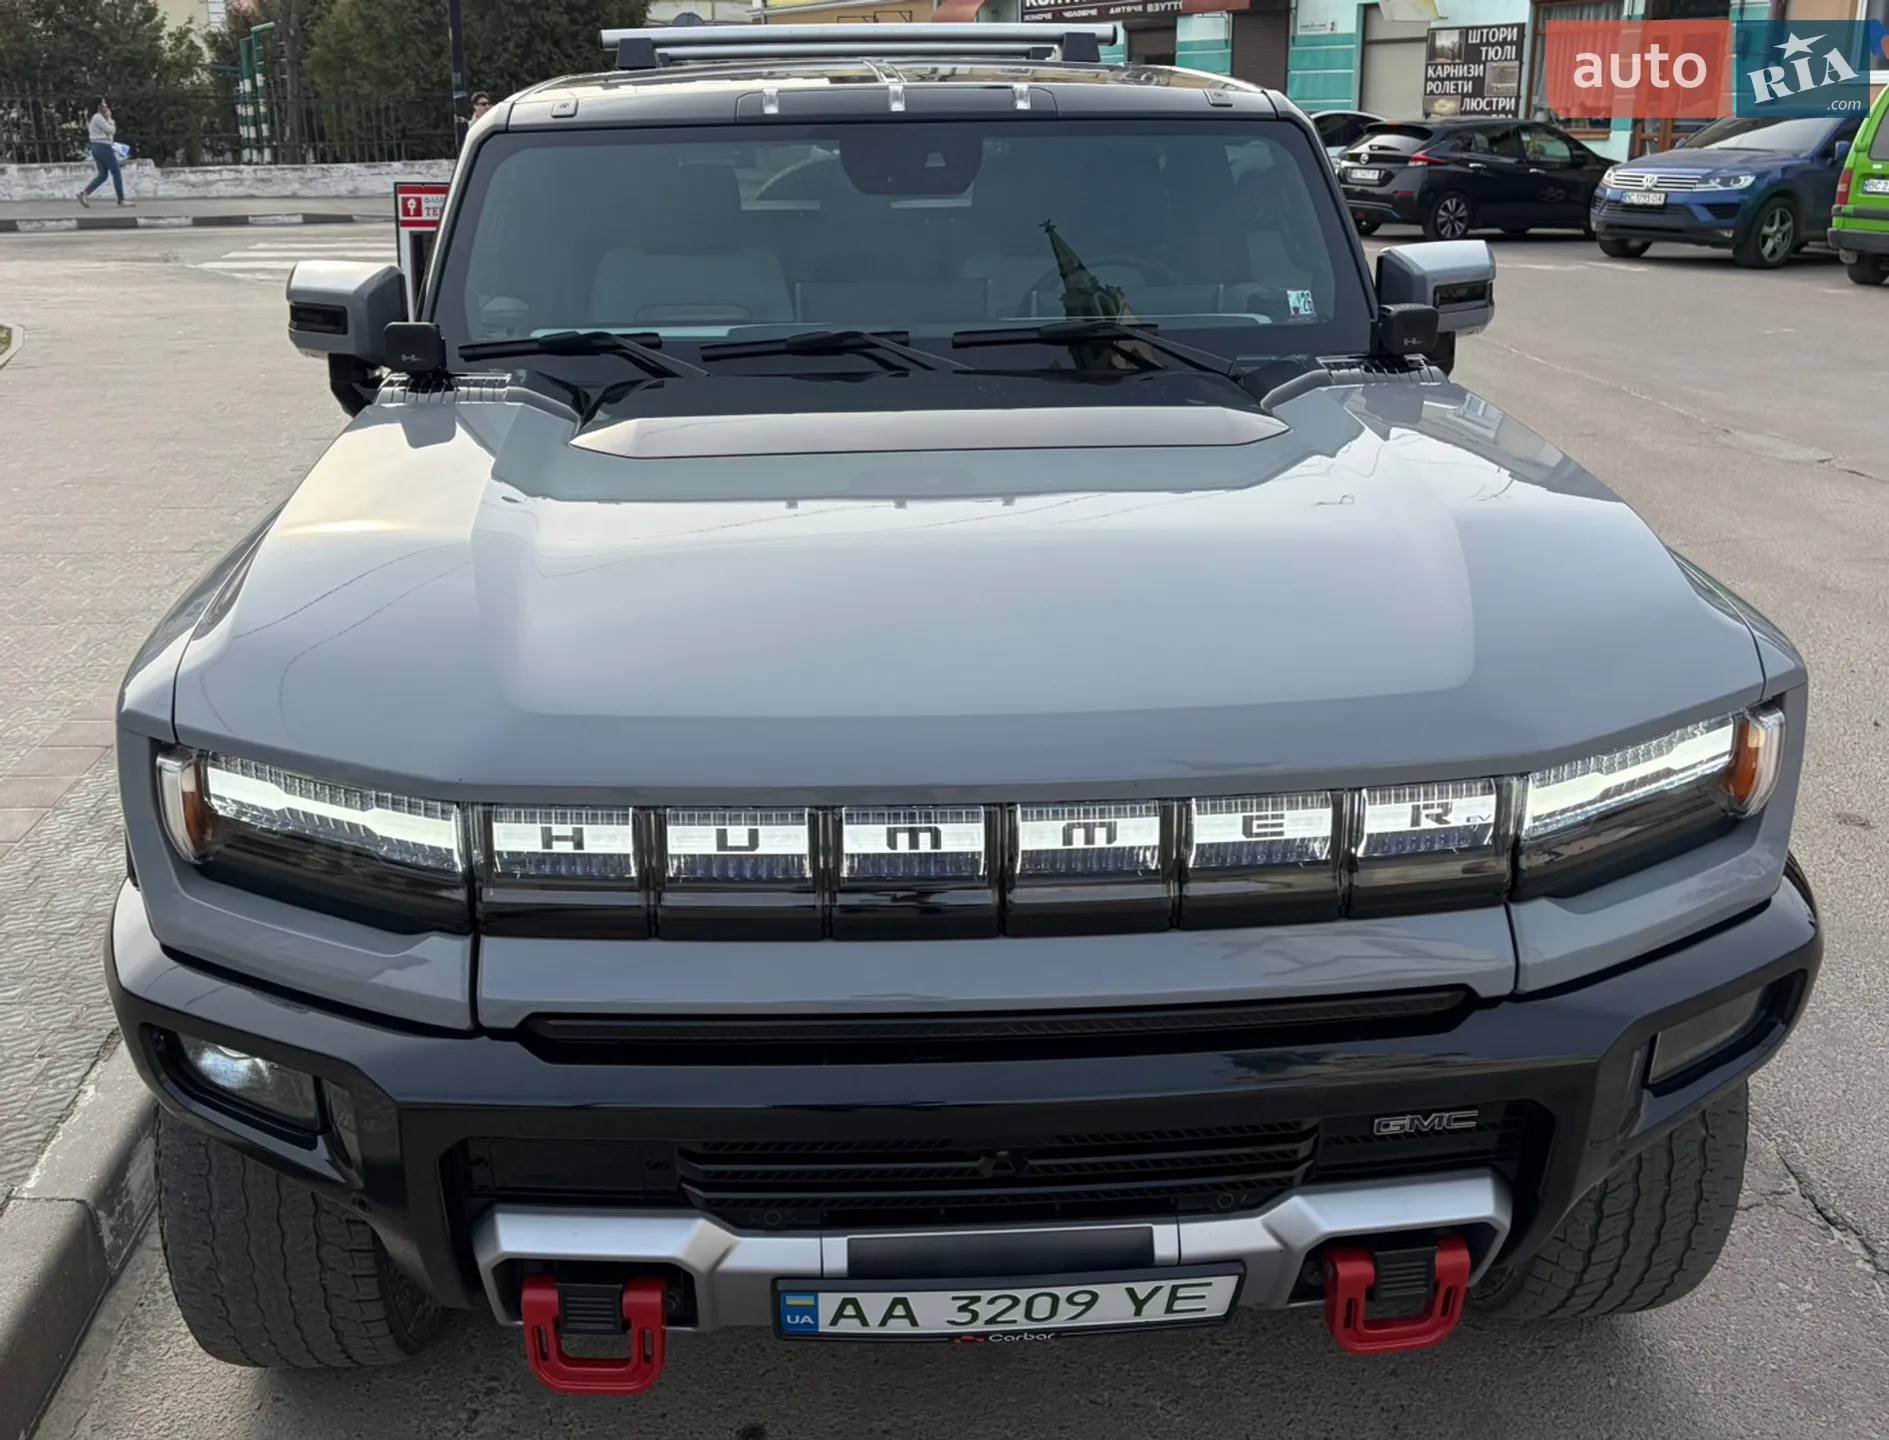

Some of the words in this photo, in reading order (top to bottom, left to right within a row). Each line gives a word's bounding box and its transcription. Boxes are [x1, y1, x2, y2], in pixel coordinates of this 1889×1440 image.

[1468, 27, 1518, 44] ШТОРИ
[1480, 45, 1517, 61] ТЮЛІ
[1427, 63, 1484, 78] КАРНИЗИ
[1426, 80, 1473, 94] РОЛЕТИ
[1461, 97, 1516, 112] ЛЮСТРИ
[424, 206, 441, 217] ТЕ
[1465, 812, 1492, 824] EV
[1373, 1110, 1479, 1136] GMC
[828, 1296, 920, 1328] AA
[946, 1288, 1100, 1327] 3209
[1124, 1281, 1213, 1318] YE
[786, 1314, 815, 1325] UA
[988, 1332, 1056, 1342] Carbar
